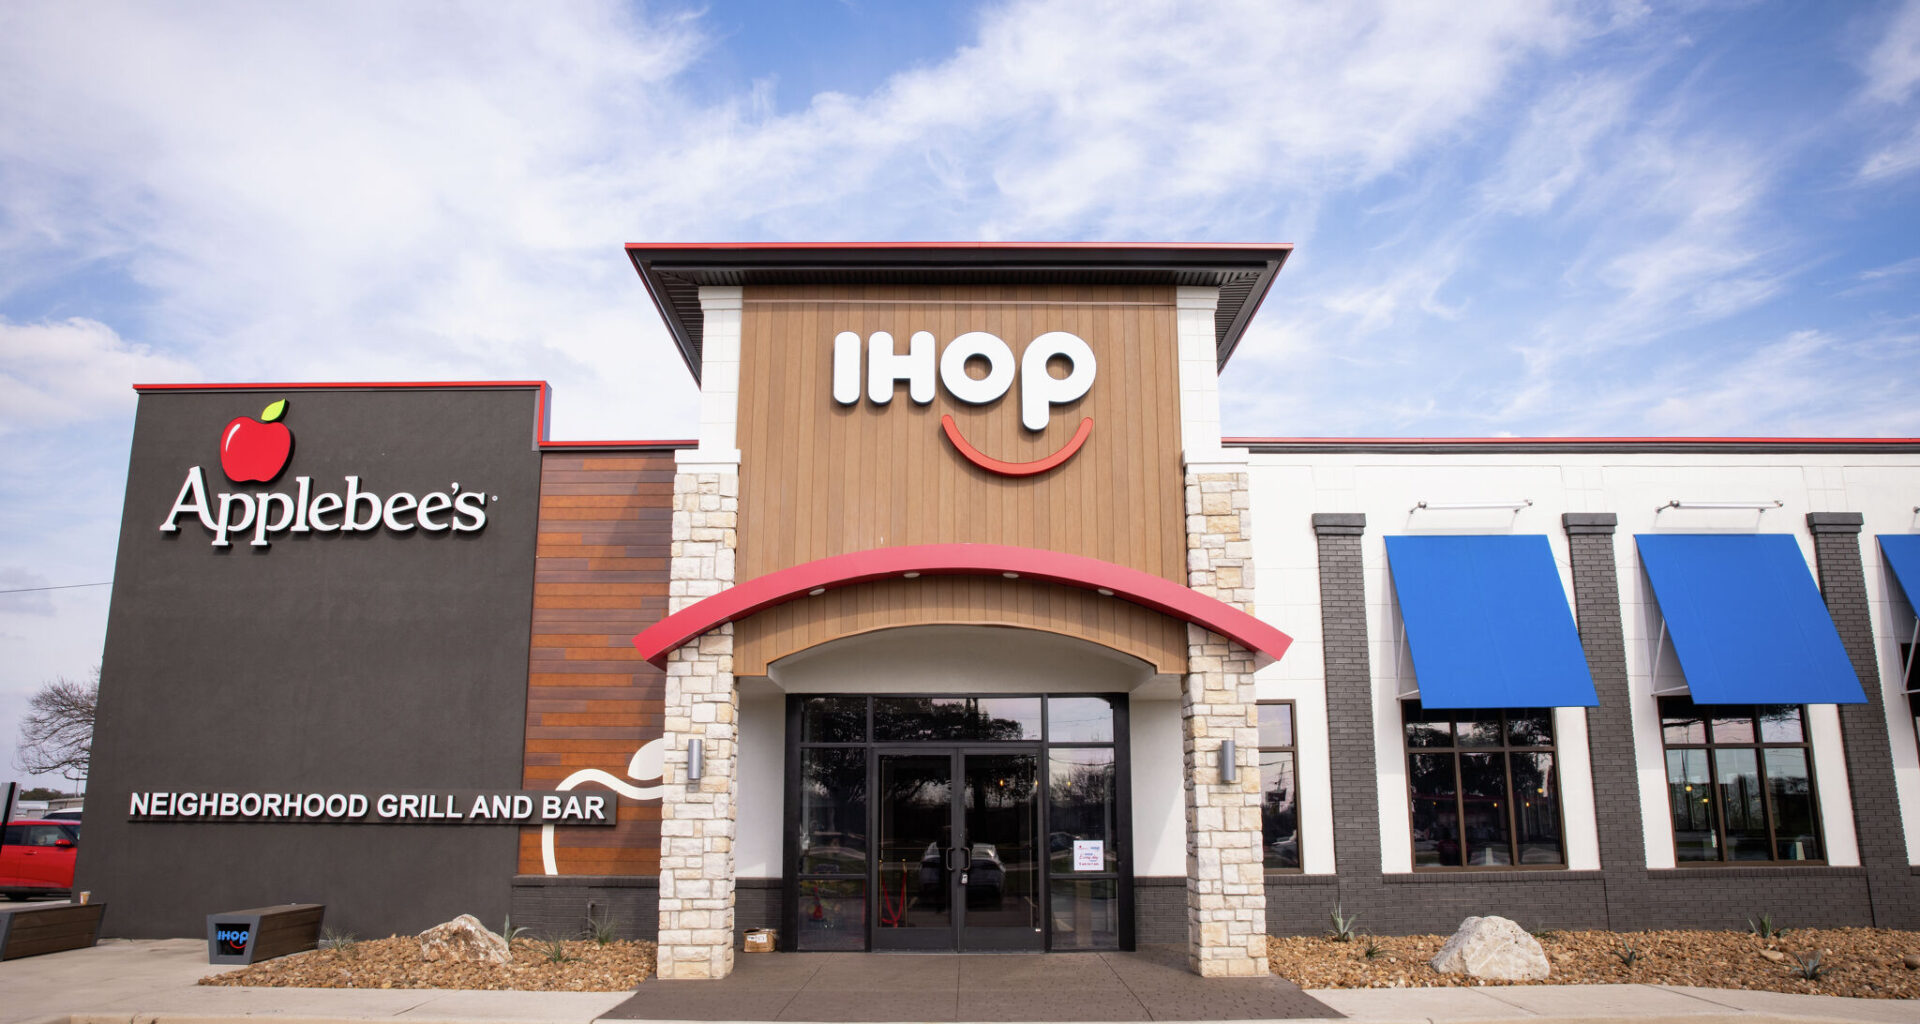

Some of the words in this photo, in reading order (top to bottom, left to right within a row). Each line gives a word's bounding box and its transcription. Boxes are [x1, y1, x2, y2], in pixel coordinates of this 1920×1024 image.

[833, 330, 1097, 431] IHOP
[159, 465, 486, 546] Applebee's
[129, 792, 368, 818] NEIGHBORHOOD
[377, 793, 463, 819] GRILL
[469, 794, 533, 820] AND
[542, 795, 605, 820] BAR
[217, 930, 248, 944] IHOP
